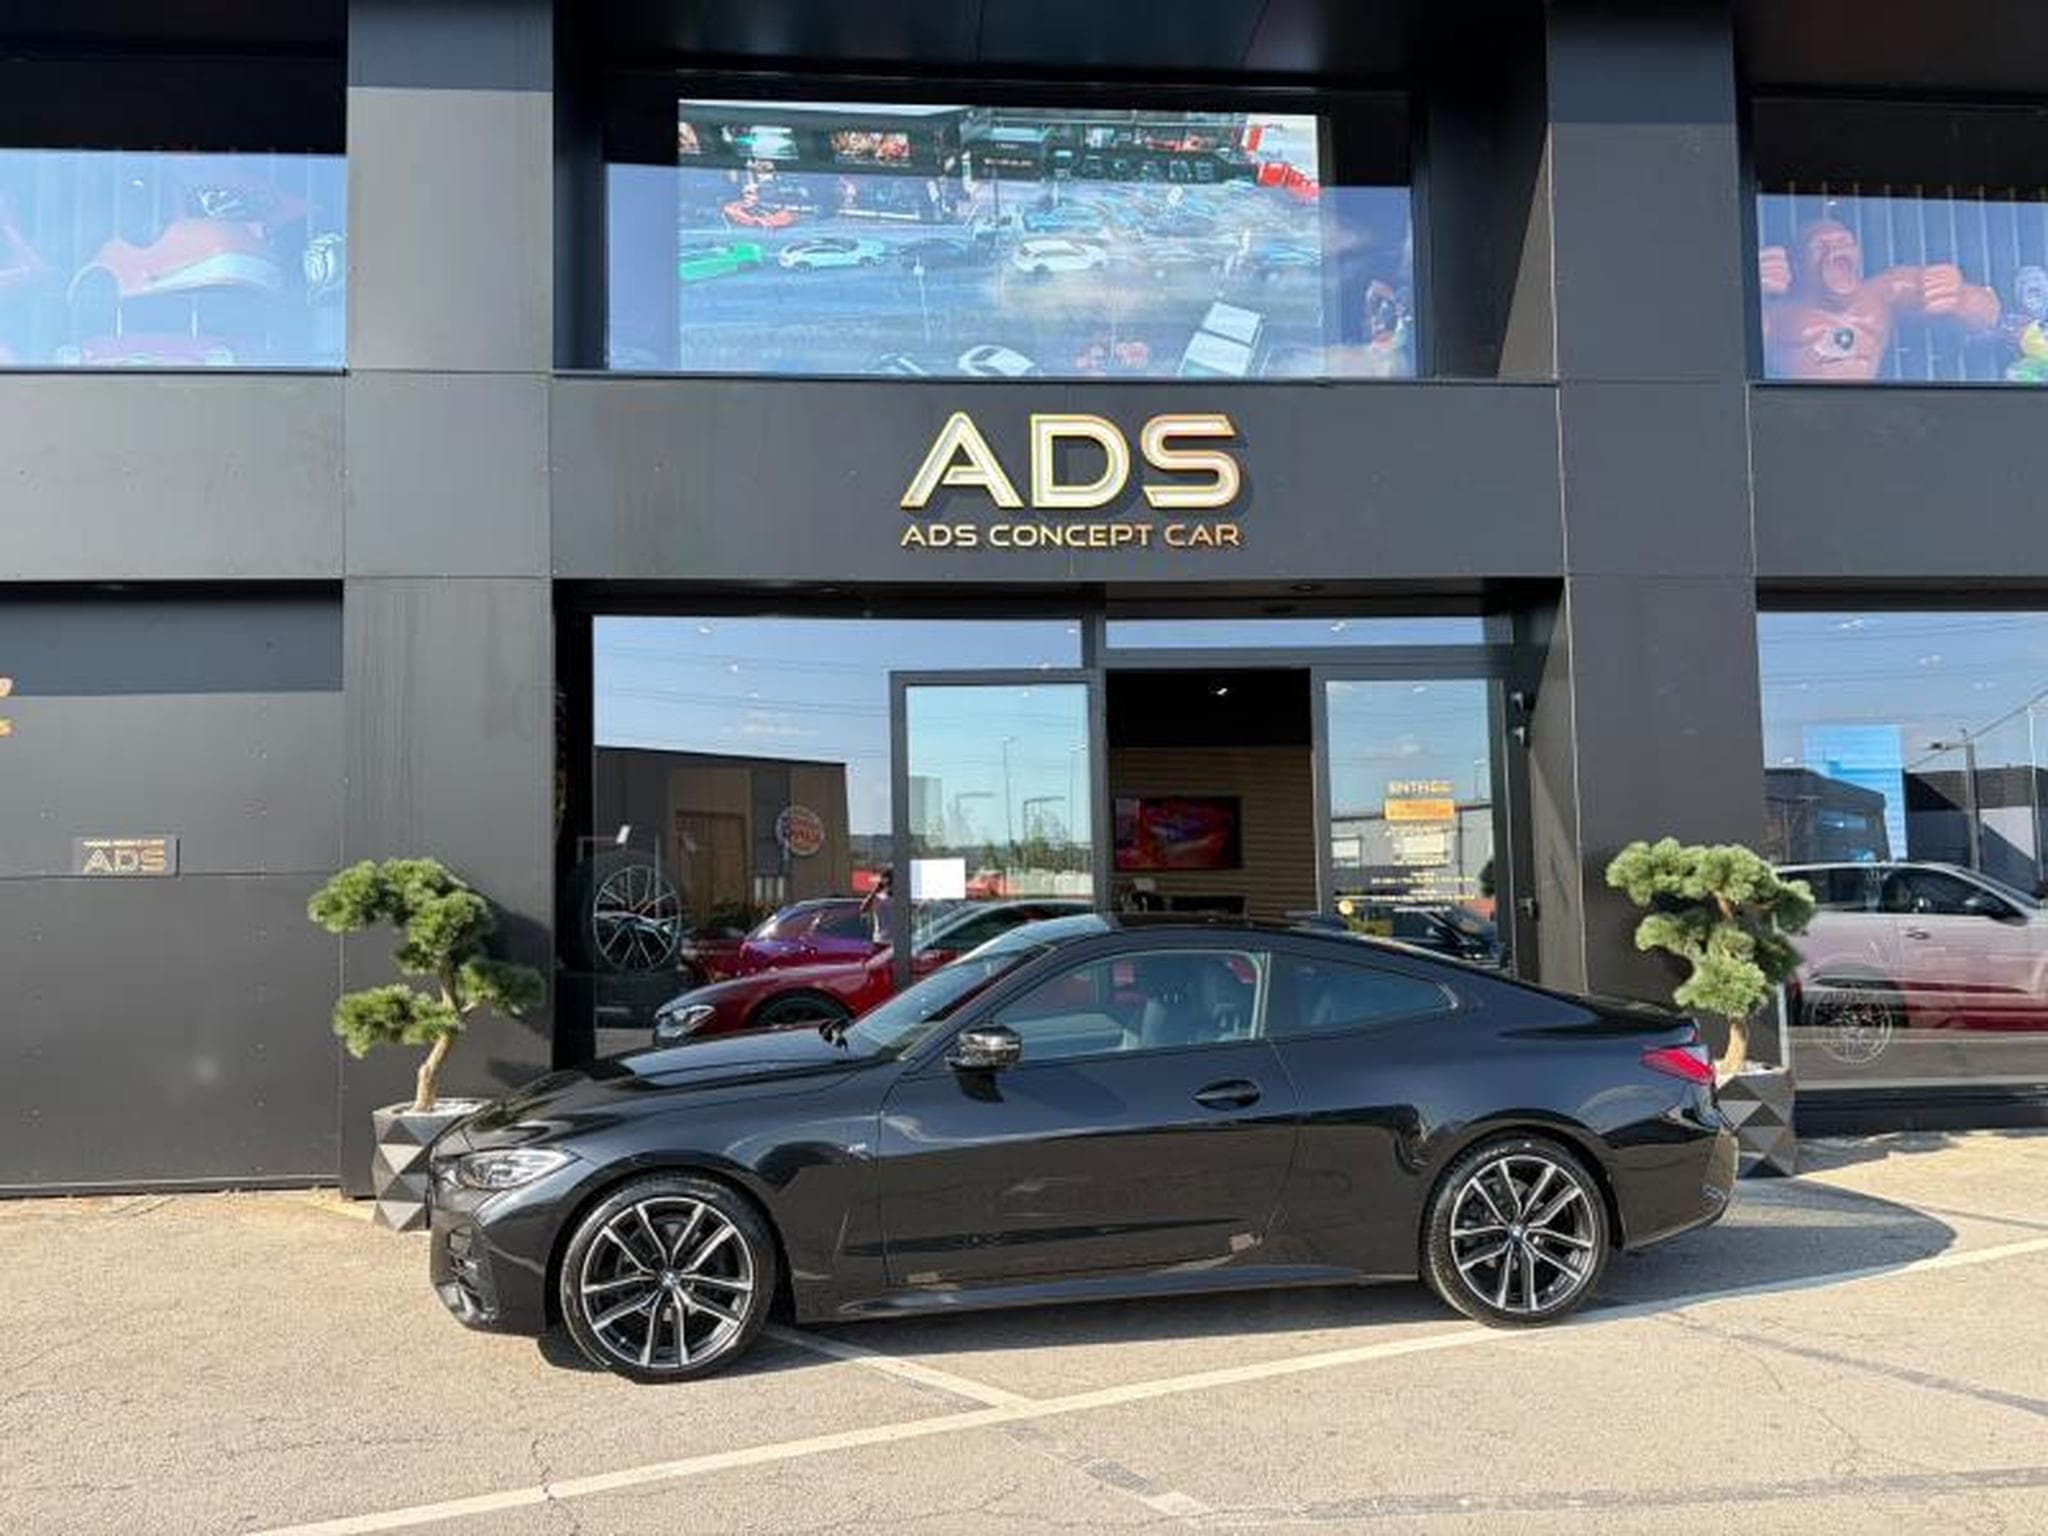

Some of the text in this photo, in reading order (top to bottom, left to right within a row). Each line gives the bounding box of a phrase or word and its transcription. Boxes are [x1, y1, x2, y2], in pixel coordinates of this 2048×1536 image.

[900, 411, 1241, 508] ADS
[900, 524, 1241, 547] ADS CONCEPT CAR
[83, 846, 166, 873] ADS
